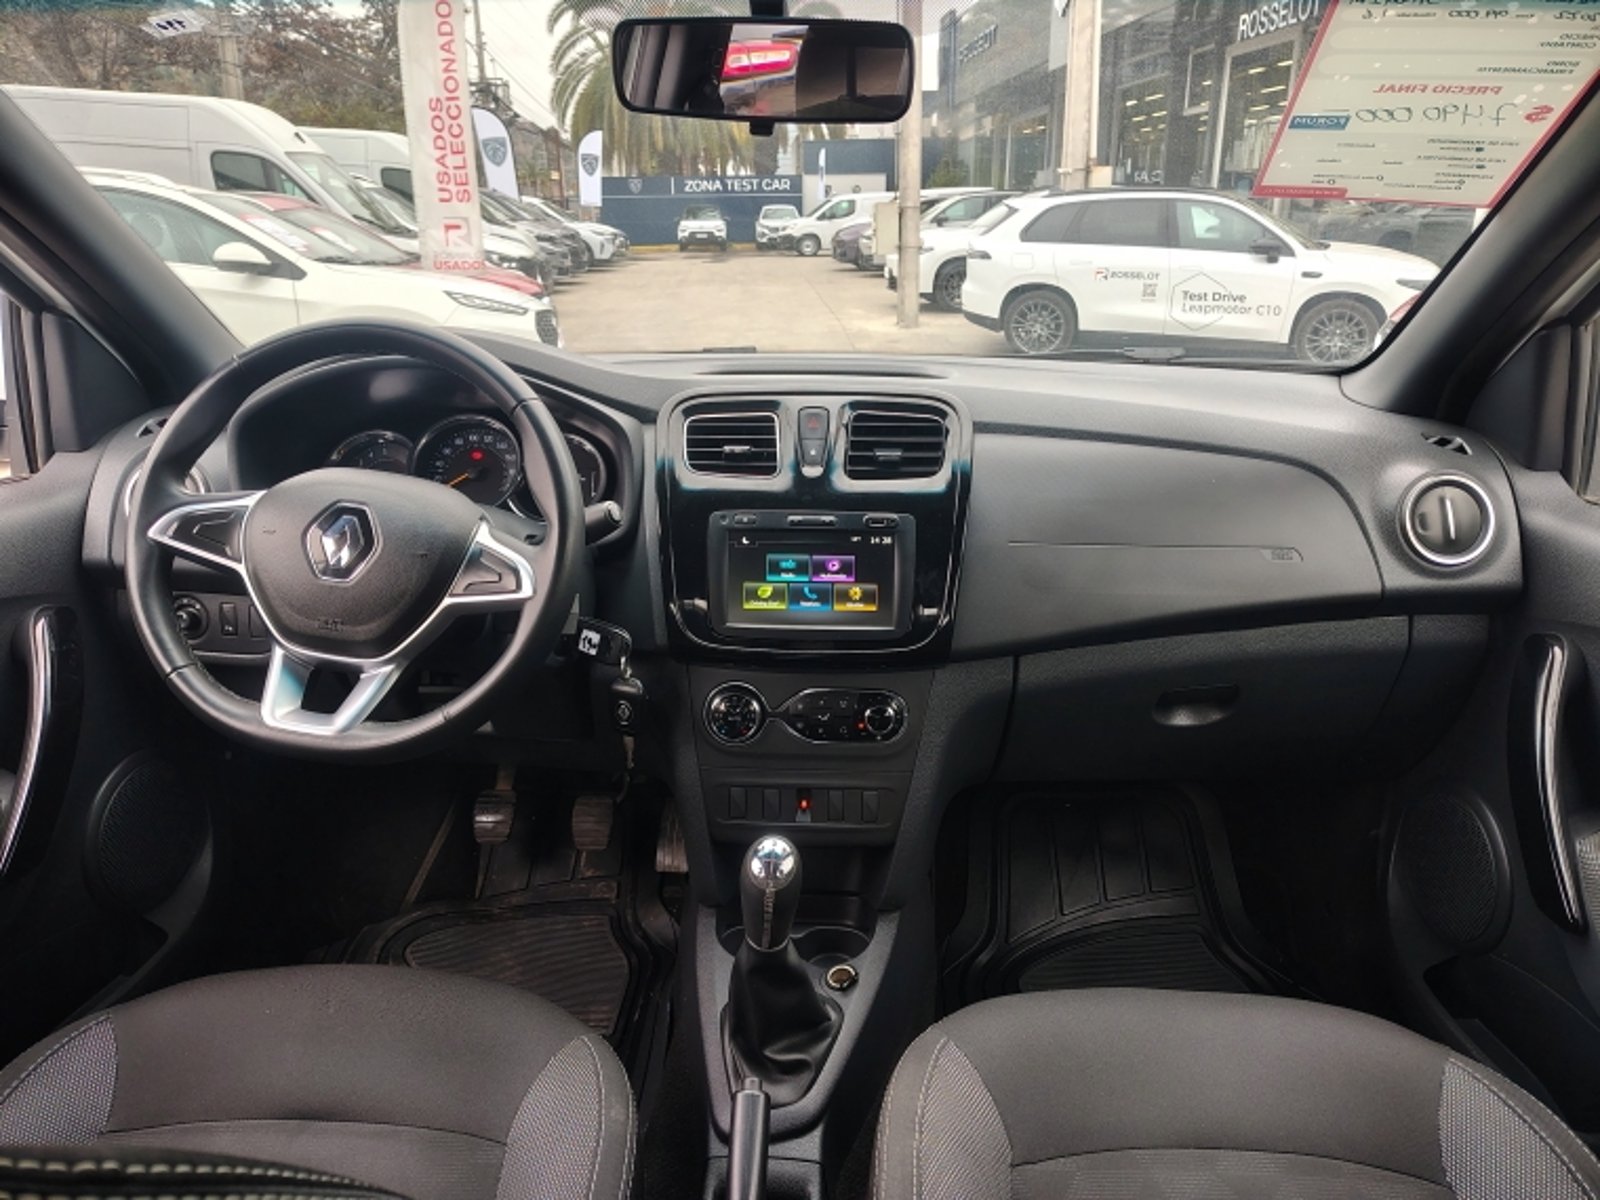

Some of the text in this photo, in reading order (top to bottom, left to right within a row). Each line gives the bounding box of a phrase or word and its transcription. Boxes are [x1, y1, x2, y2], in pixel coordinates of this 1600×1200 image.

[428, 97, 453, 204] USADOS
[684, 178, 791, 193] ZONA TEST CAR
[1181, 290, 1248, 304] Test Drive
[1181, 302, 1283, 317] Leapmotor C10
